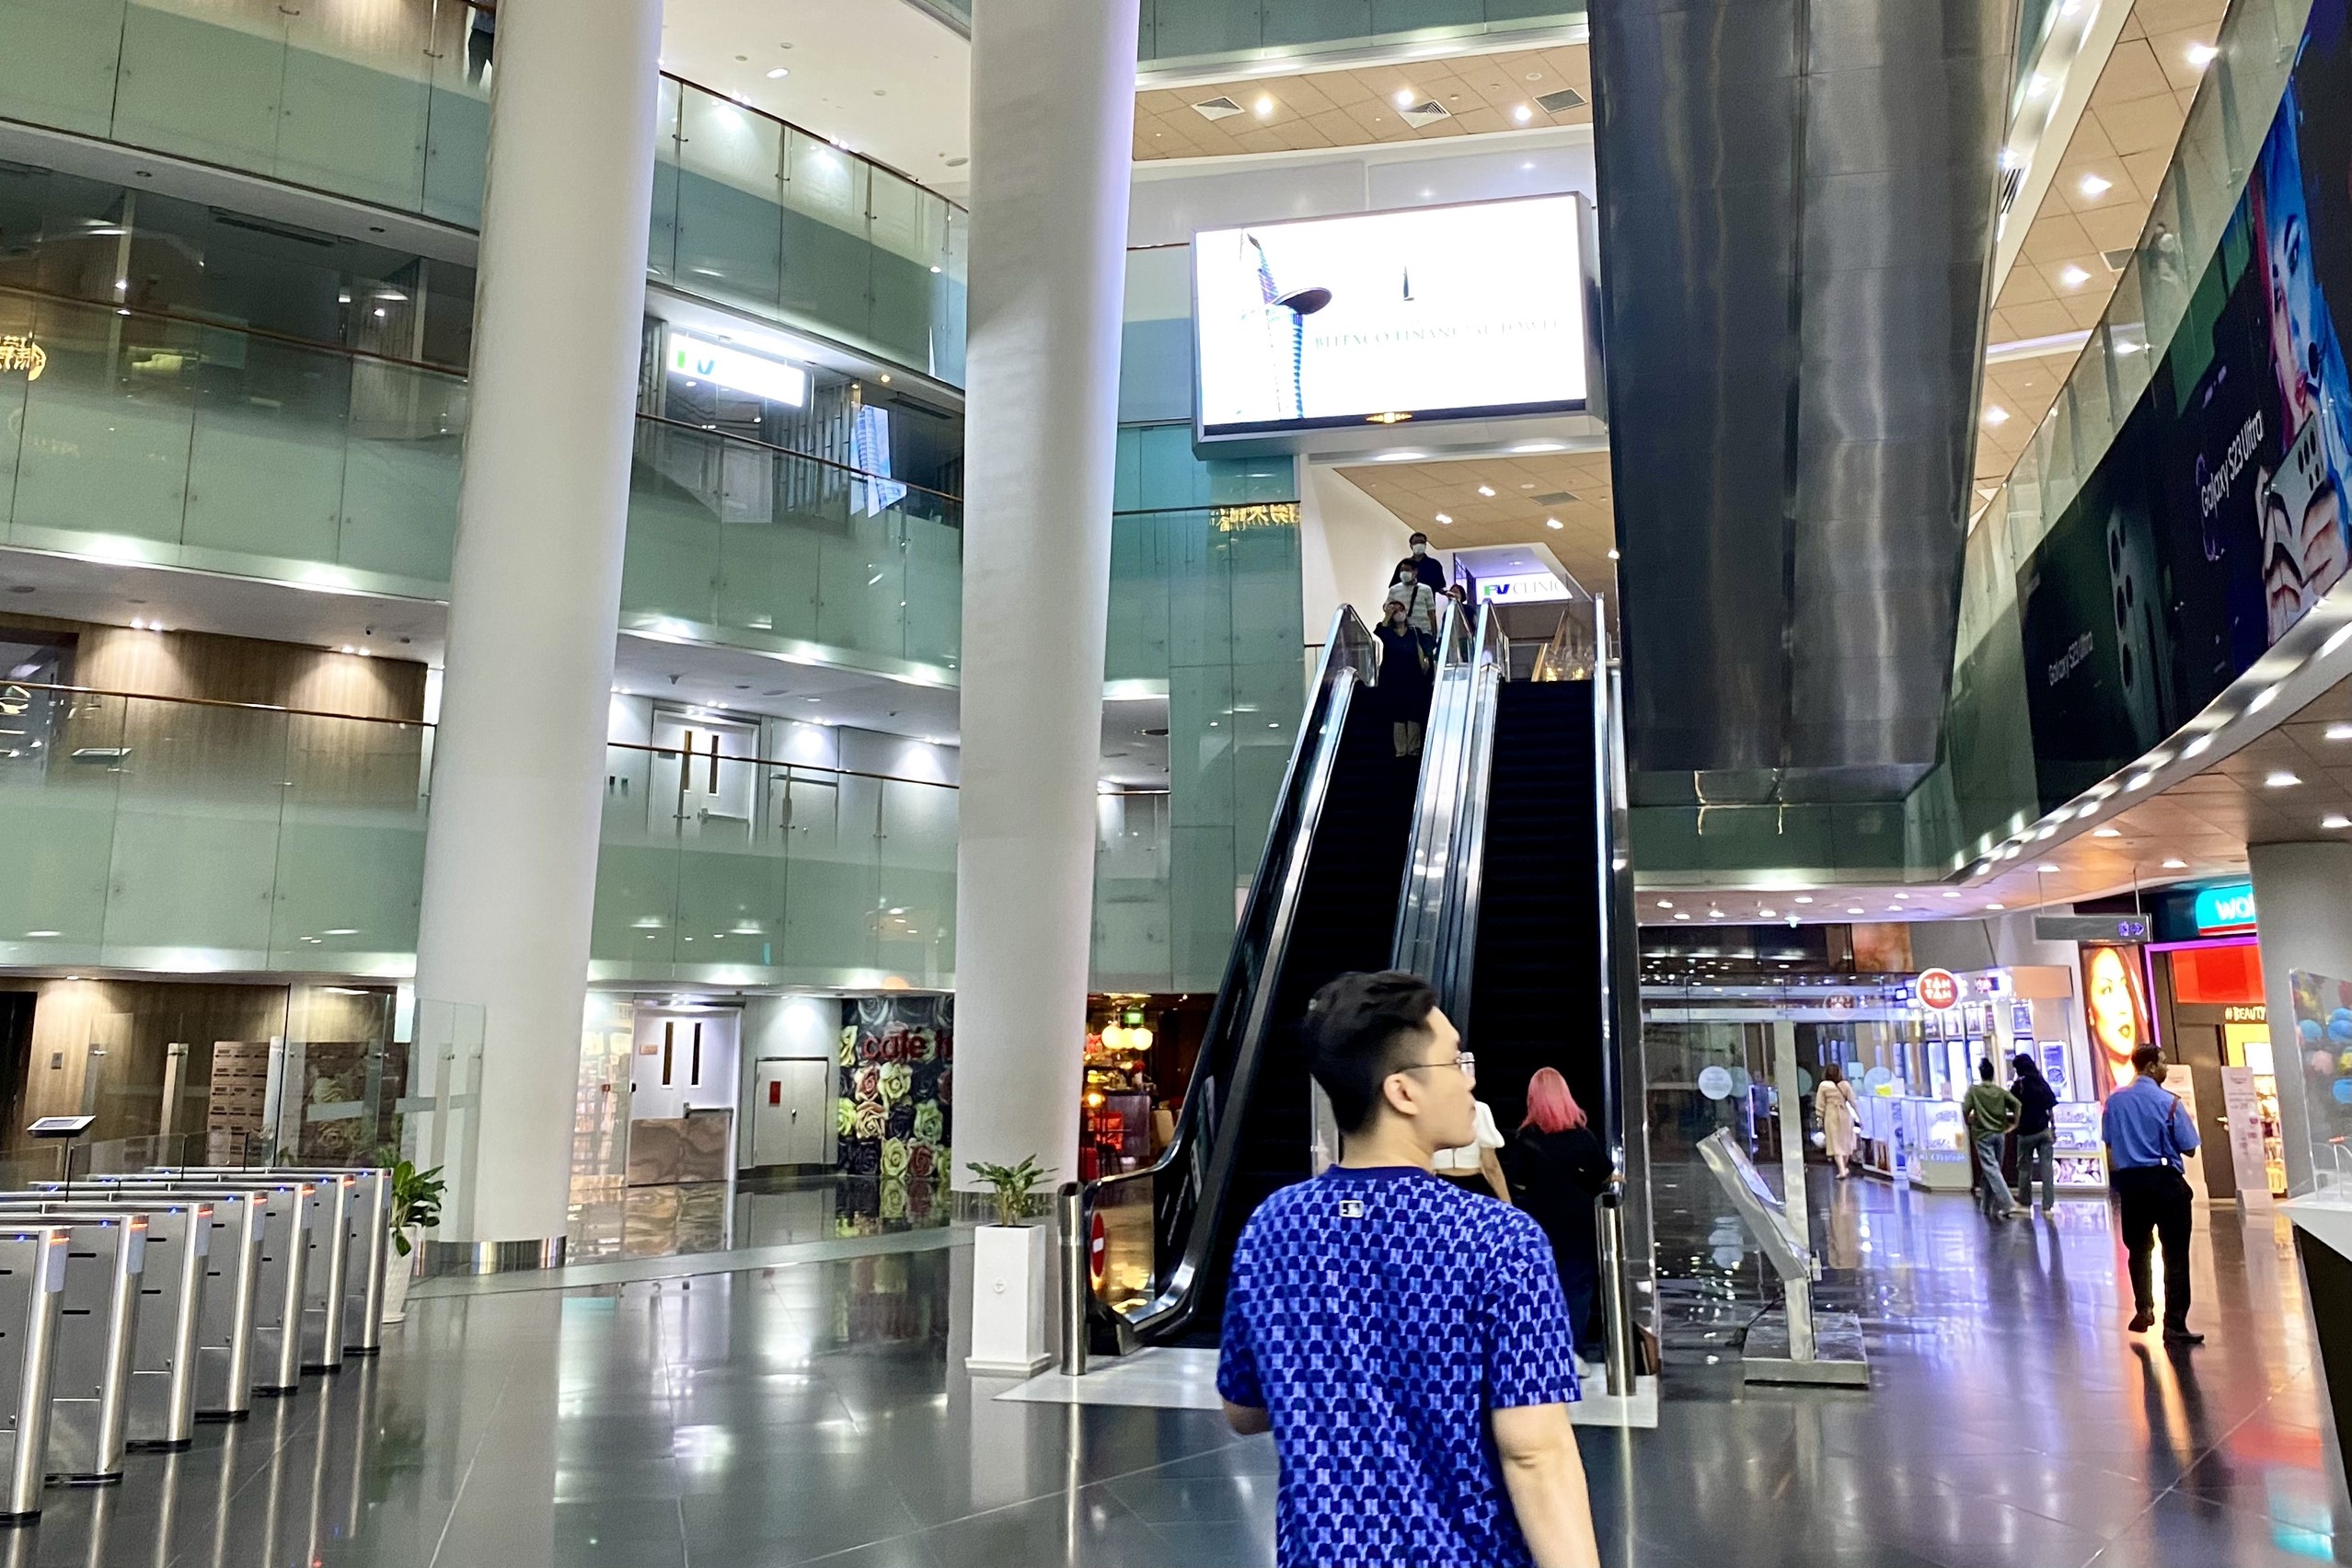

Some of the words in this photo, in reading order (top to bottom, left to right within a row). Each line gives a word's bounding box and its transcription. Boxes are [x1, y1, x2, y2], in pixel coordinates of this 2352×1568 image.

[1395, 323, 1488, 341] FINANCAL
[2201, 460, 2229, 518] Galaxy
[2228, 434, 2243, 480] S23
[2241, 409, 2264, 460] Ultra
